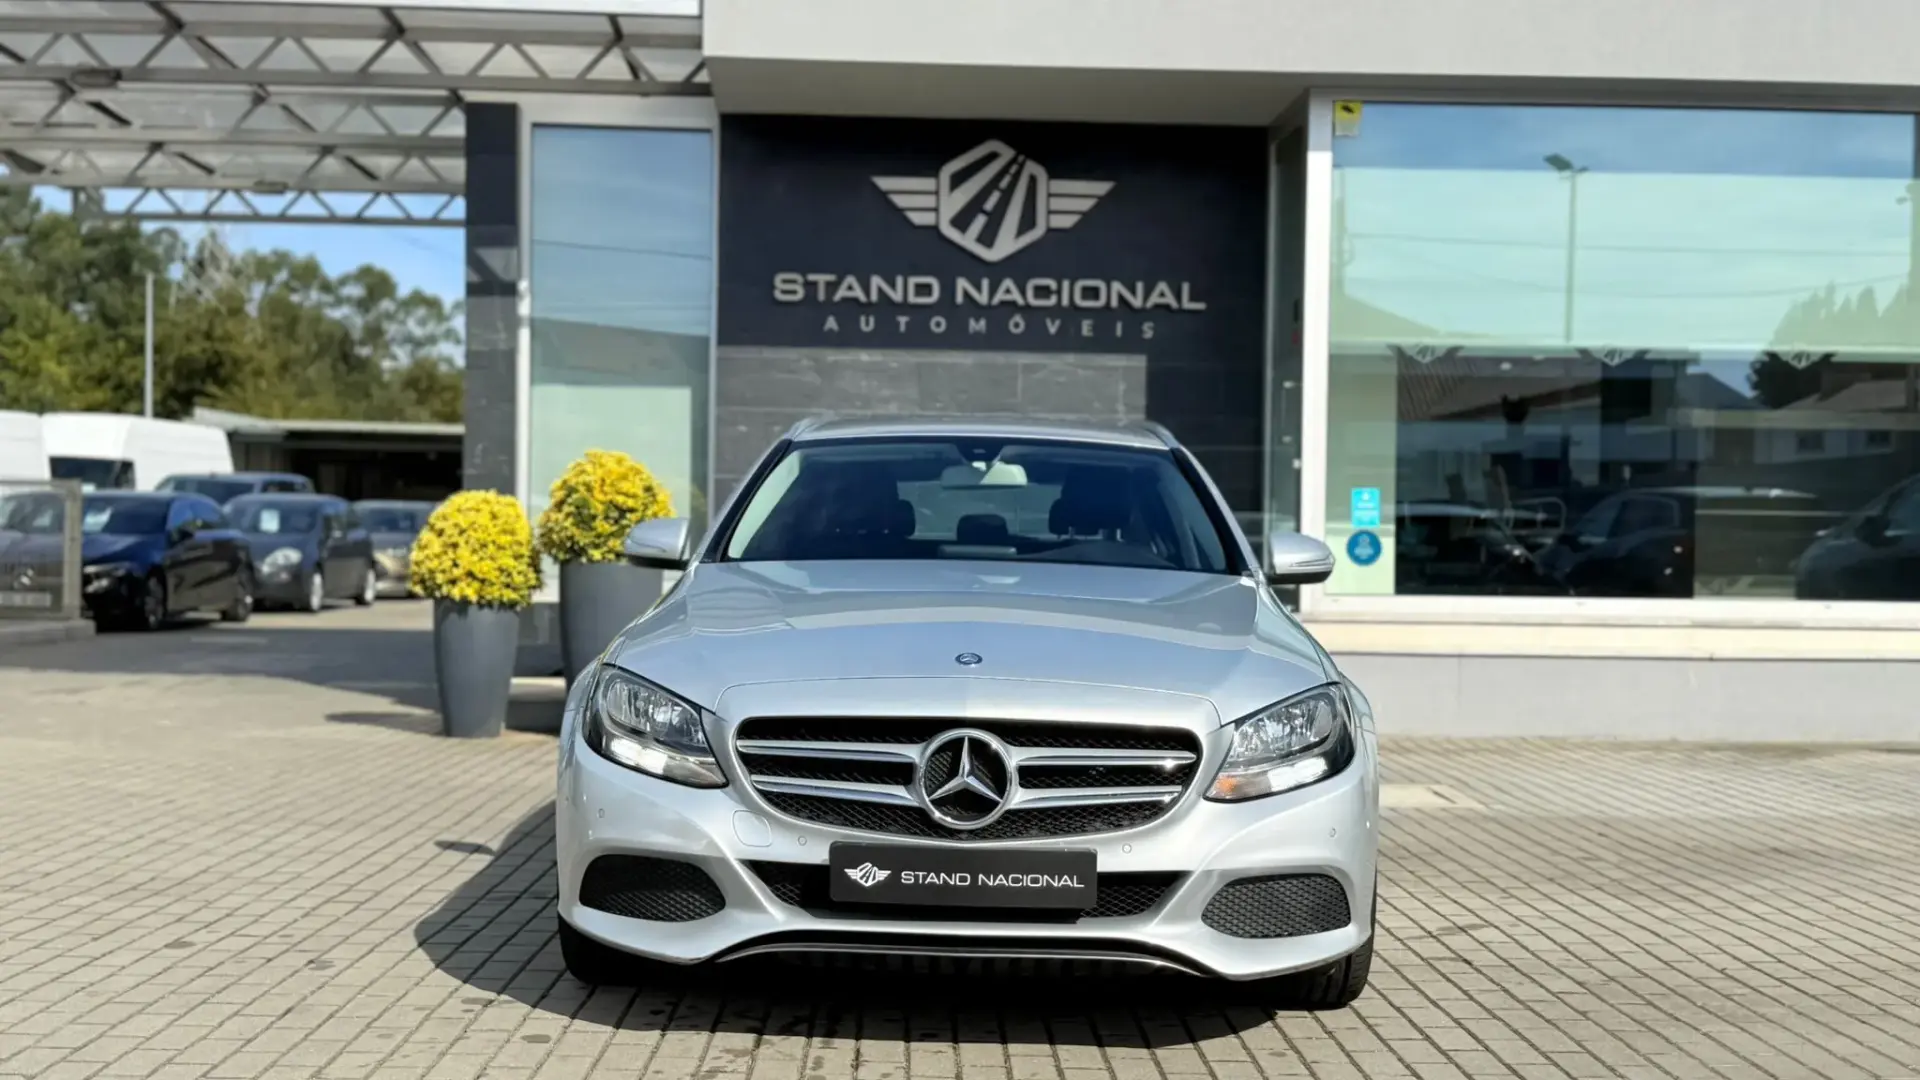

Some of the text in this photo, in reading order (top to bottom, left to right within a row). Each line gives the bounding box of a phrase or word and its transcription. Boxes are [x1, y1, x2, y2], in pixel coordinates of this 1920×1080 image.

[772, 272, 1207, 311] STAND NACIONAL
[823, 313, 1155, 339] AUTOMÓVEIS
[900, 870, 1085, 888] STAND NACIONAL
